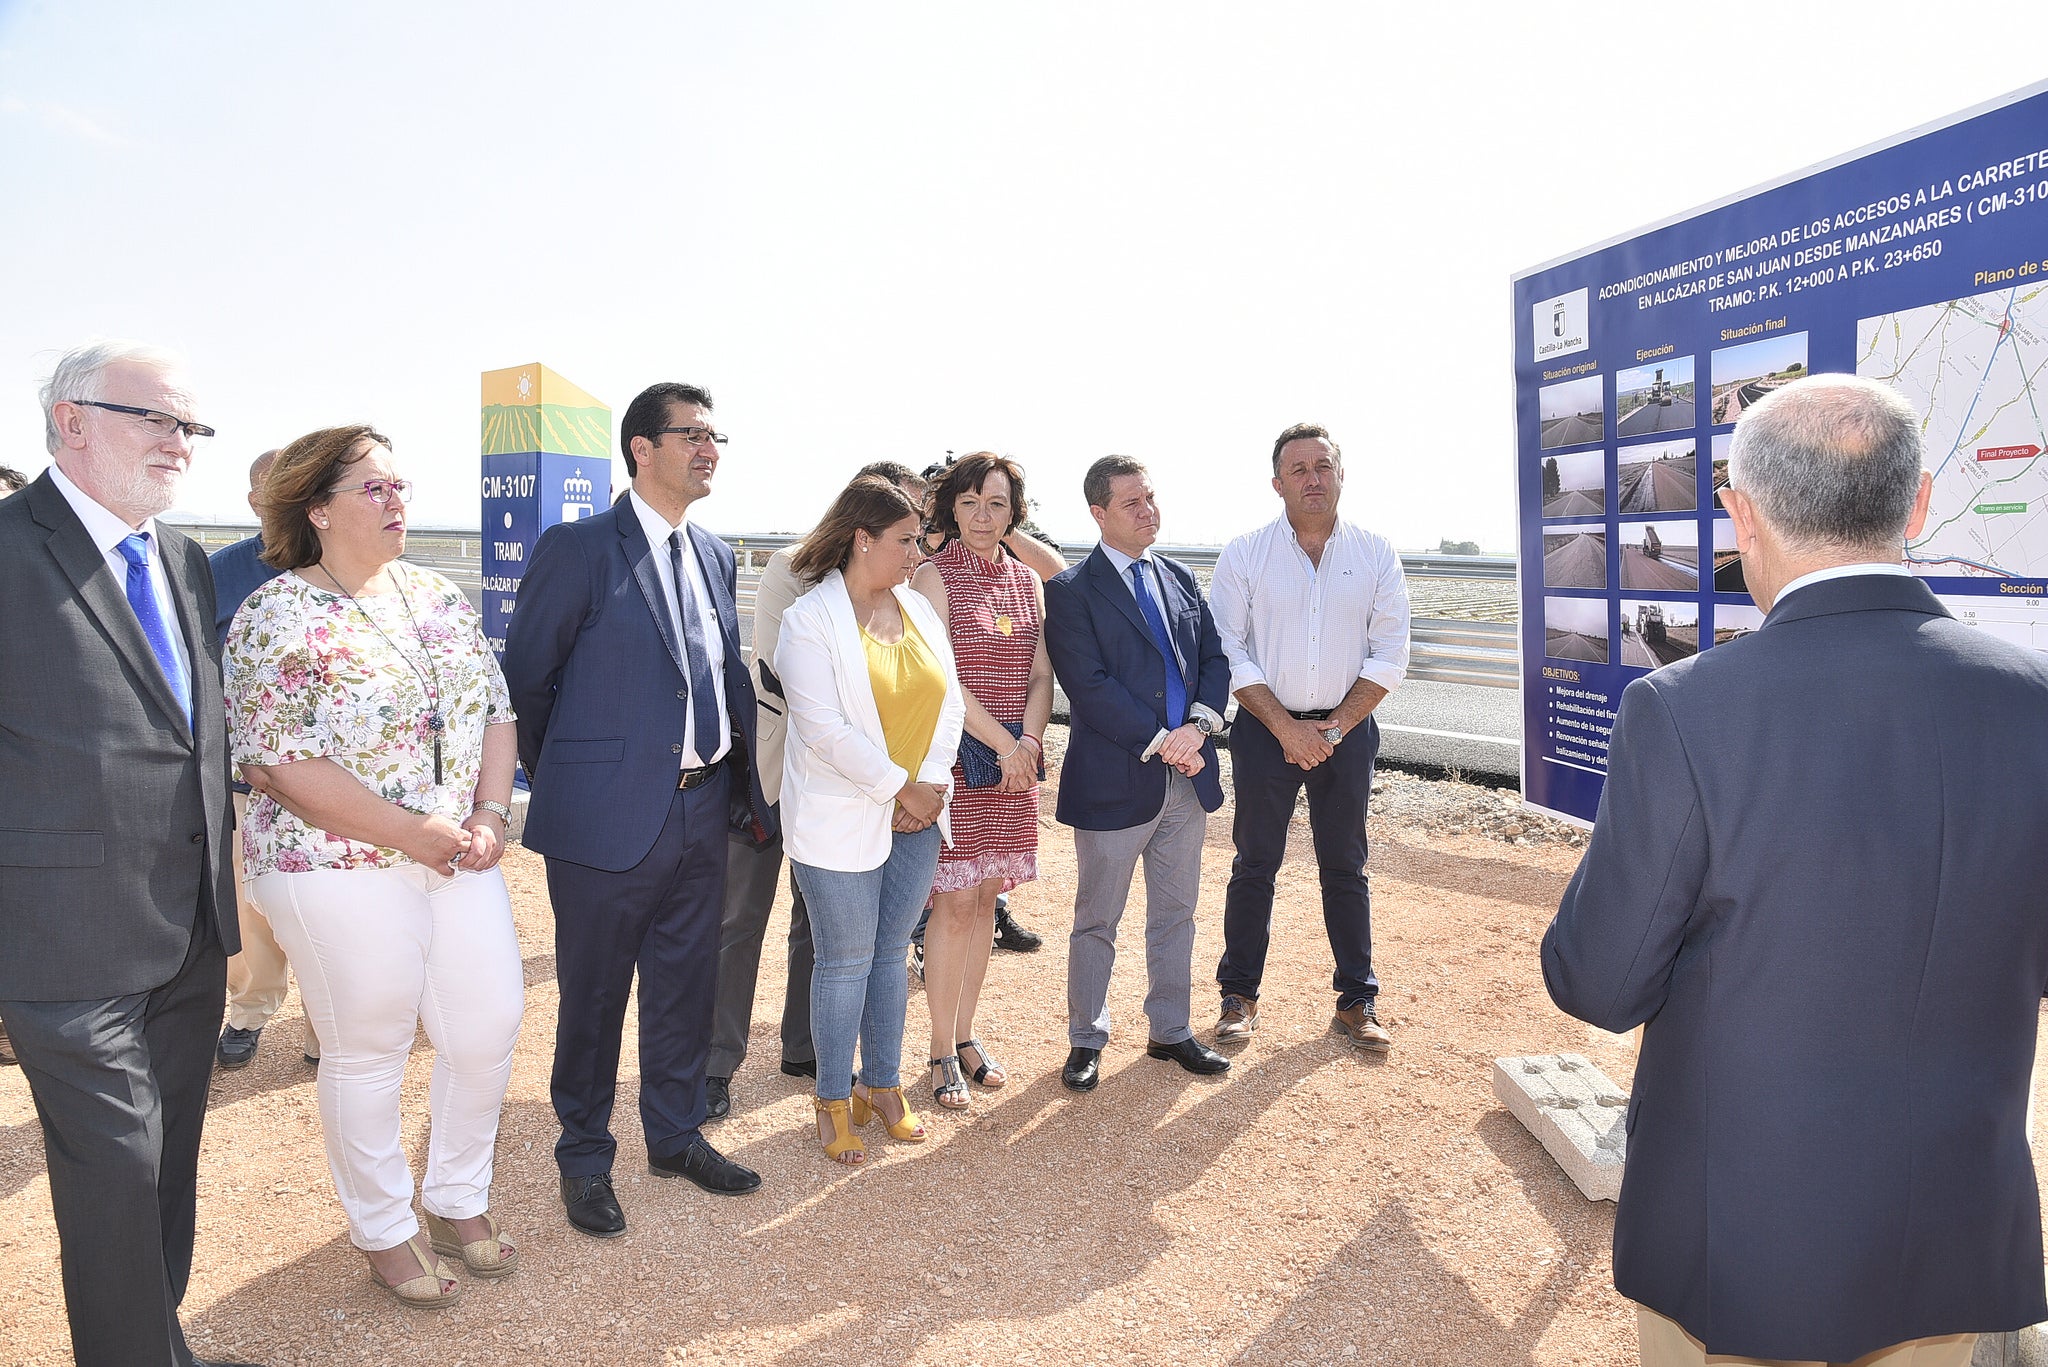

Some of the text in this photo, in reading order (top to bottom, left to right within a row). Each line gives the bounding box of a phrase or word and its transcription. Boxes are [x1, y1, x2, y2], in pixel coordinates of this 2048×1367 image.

[1598, 149, 2048, 301] ACONDICIONAMIENTO Y MEJORA DE LOS ACCESOS A LA CARRETE
[1638, 180, 2048, 310] EN ALCÁZAR DE SAN JUAN DESDE MANZANARES ( CM-310
[1709, 240, 1942, 313] TRAMO: P.K. 12+000 A P.K. 23+650
[1974, 266, 2015, 287] Plano
[2018, 261, 2038, 277] de
[1720, 316, 1787, 341] Situación final
[1539, 336, 1582, 354] Castilla-La Mancha
[1636, 344, 1674, 362] Ejecución
[1543, 359, 1597, 380] Situación original
[1980, 447, 2029, 458] Final Proyecto
[482, 474, 536, 499] CM-3107
[493, 542, 523, 562] TRAMO
[482, 573, 512, 592] ALCÁZAR
[2000, 582, 2043, 594] Sección
[1542, 666, 1580, 681] OBJETIVOS:
[1556, 686, 1608, 703] Mejora del drenaje
[1556, 701, 1595, 716] Rehabilitación
[1596, 708, 1606, 718] del
[1556, 716, 1580, 729] Aumento
[1581, 721, 1589, 730] de
[1589, 722, 1595, 732] la
[1556, 731, 1588, 745] Renovación
[1556, 745, 1591, 762] balizamiento
[1591, 756, 1596, 764] y
